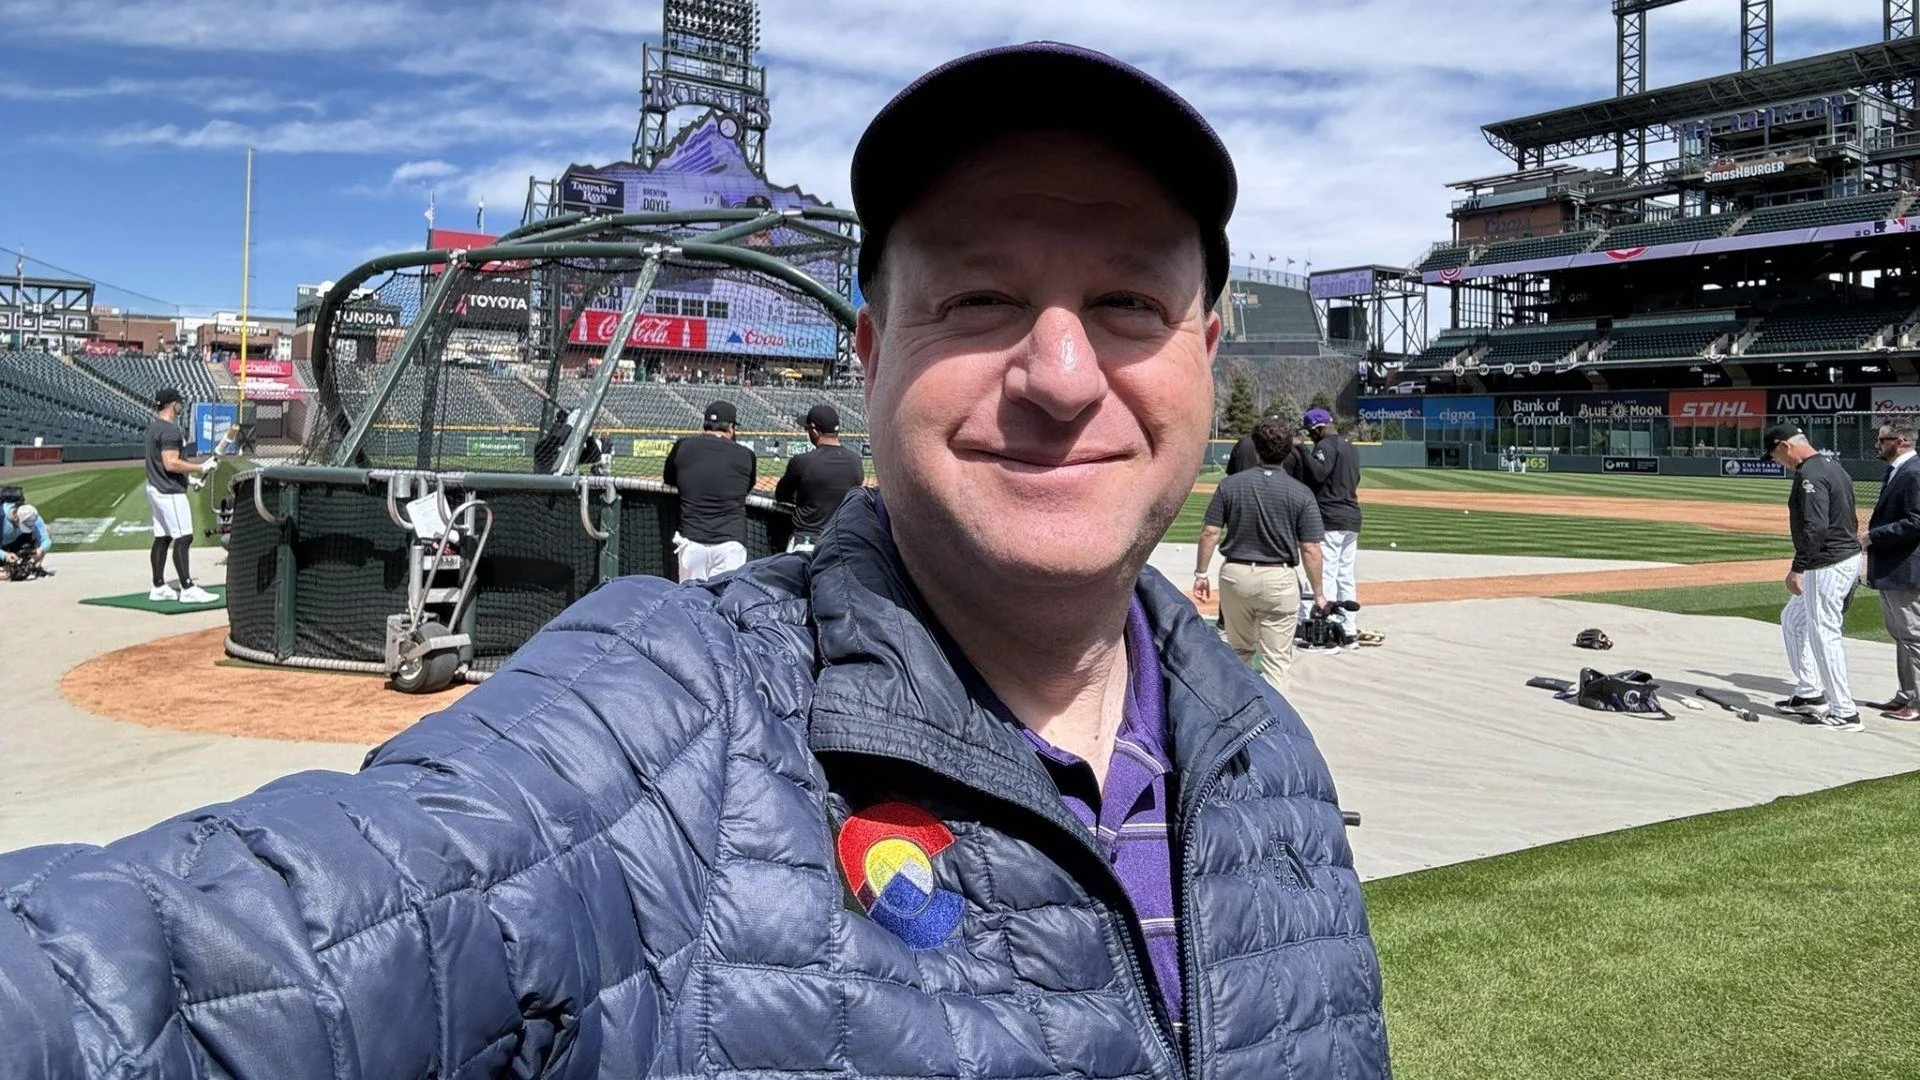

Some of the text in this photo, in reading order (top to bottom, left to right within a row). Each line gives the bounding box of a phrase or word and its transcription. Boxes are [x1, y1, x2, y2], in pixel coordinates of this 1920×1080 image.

[571, 181, 618, 195] TAMPA BAY
[642, 198, 671, 213] DOYLE
[468, 294, 527, 311] TOYOTA
[335, 310, 394, 326] TUNDRA
[743, 327, 784, 347] Coors
[1513, 397, 1561, 412] Bank of
[1680, 401, 1754, 417] STIHL
[1776, 392, 1857, 410] ARROW
[1358, 408, 1413, 421] Southwest
[1439, 408, 1476, 424] cigna
[1513, 411, 1572, 426] Colorado
[1578, 403, 1662, 419] BLUE MOON
[1742, 461, 1782, 469] COLORADO
